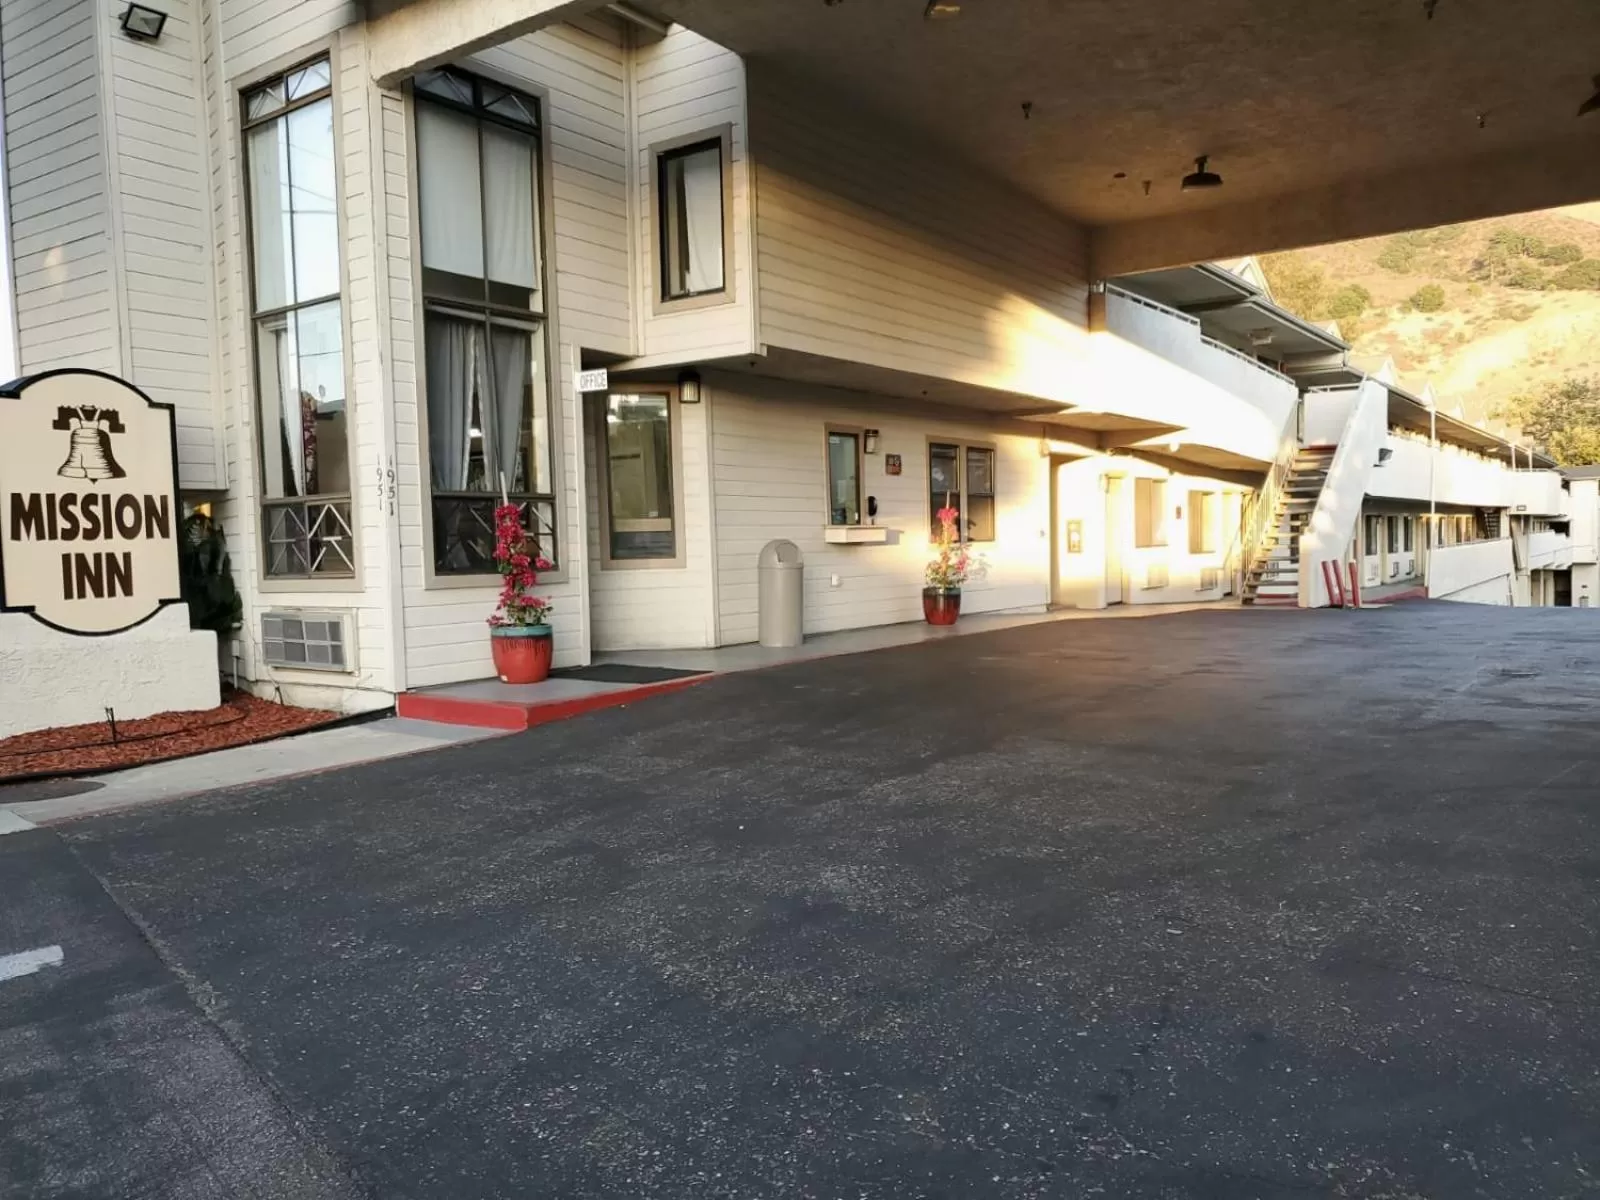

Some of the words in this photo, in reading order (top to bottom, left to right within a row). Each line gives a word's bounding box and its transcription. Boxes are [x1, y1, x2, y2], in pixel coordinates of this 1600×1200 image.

[580, 371, 607, 389] OFFICE
[387, 454, 396, 516] 1951
[10, 492, 170, 541] MISSION
[61, 551, 134, 600] INN
